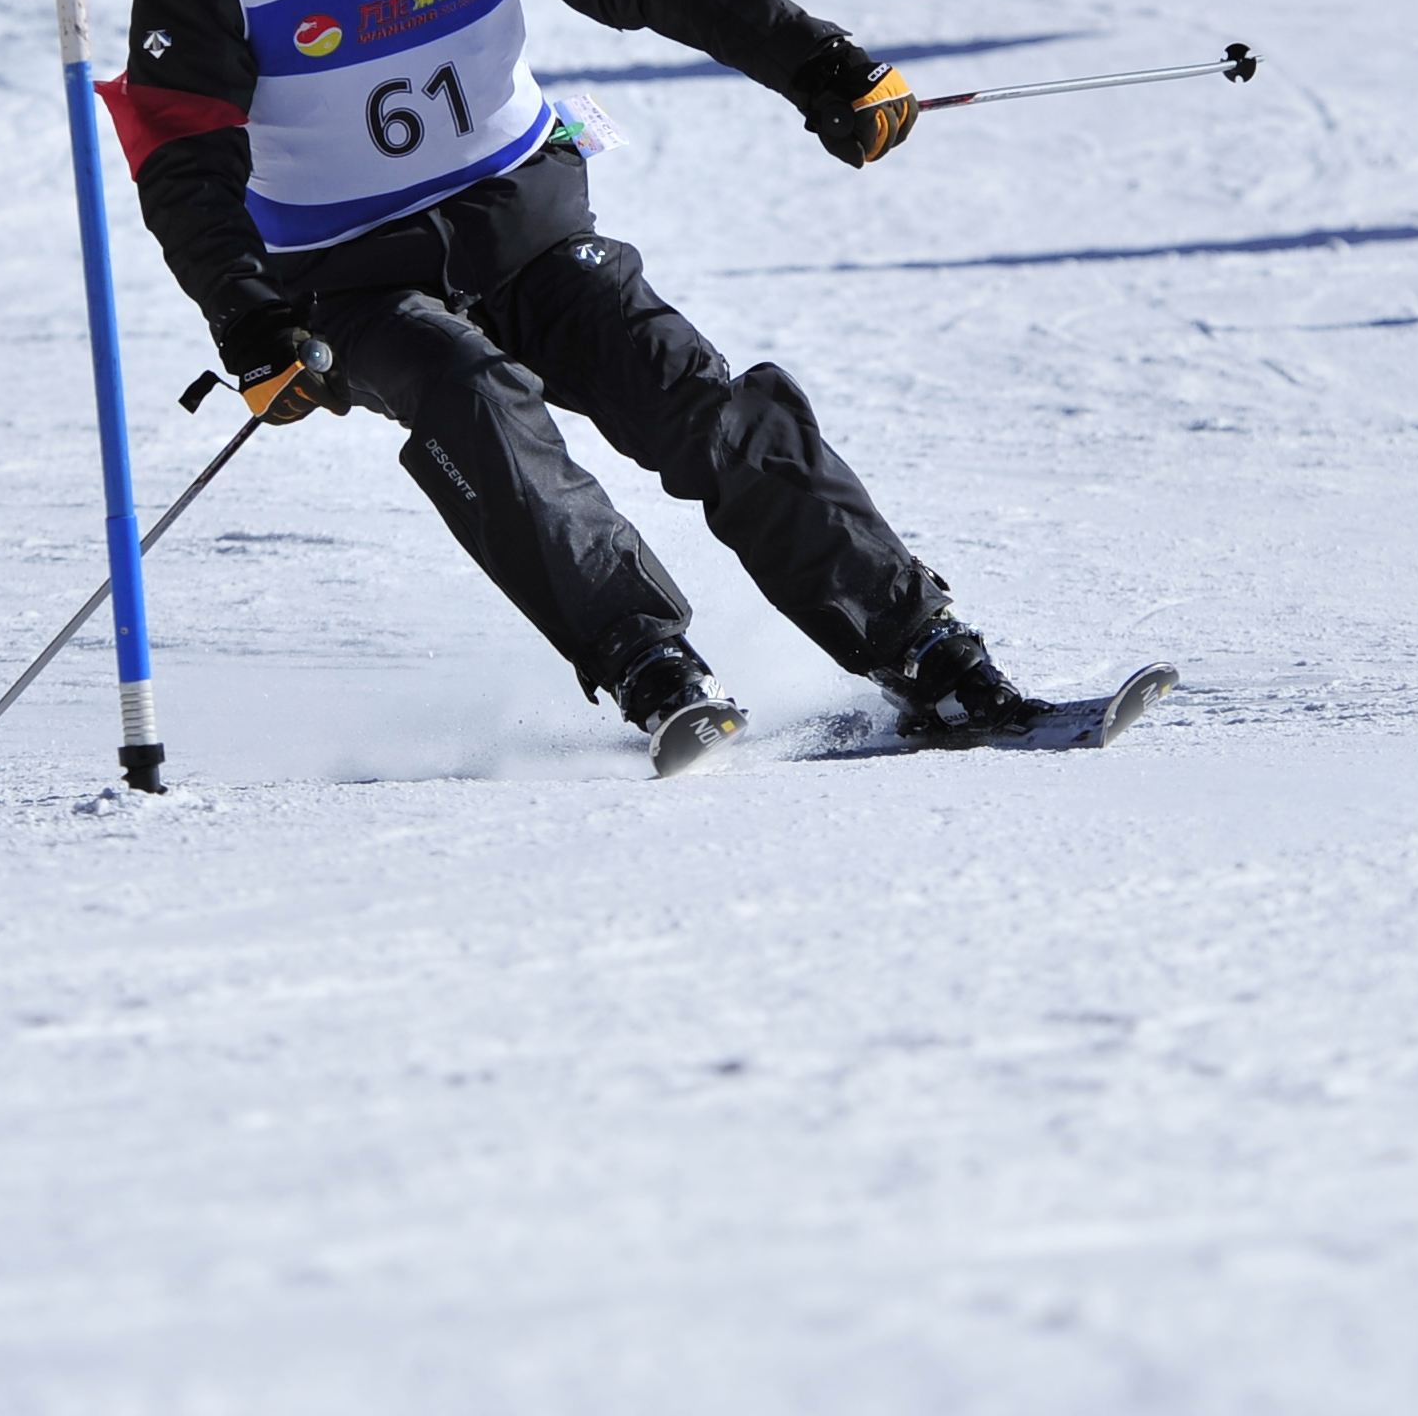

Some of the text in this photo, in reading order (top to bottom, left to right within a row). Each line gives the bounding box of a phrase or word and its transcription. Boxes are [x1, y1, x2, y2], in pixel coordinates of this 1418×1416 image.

[357, 9, 438, 44] WANLONG
[365, 60, 474, 158] 61
[425, 438, 477, 500] DESCENTE
